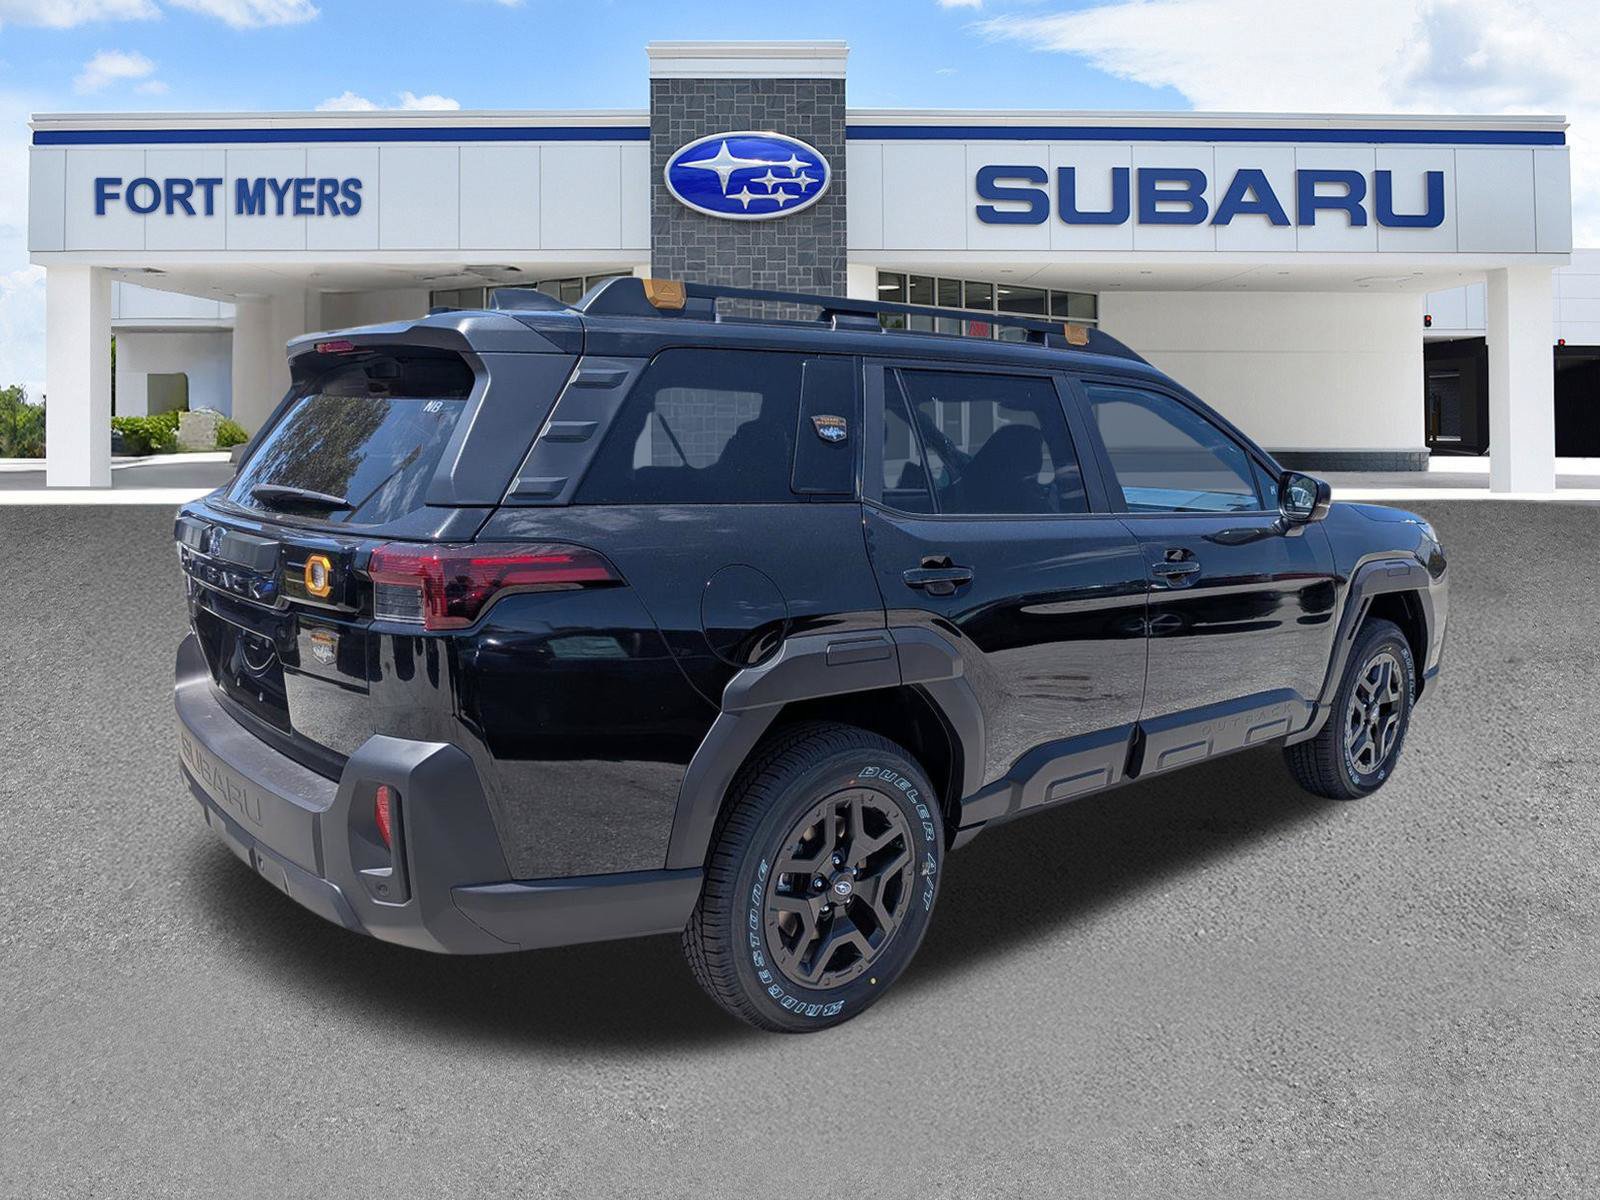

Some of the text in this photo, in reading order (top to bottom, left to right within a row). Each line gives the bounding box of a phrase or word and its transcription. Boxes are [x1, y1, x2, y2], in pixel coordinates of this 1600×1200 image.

[94, 177, 363, 217] FORT MYERS
[975, 165, 1446, 228] SUBARU
[181, 733, 264, 828] SUBARU
[858, 766, 937, 911] DUELER A/T
[749, 858, 846, 1017] BRIDGESTONE
